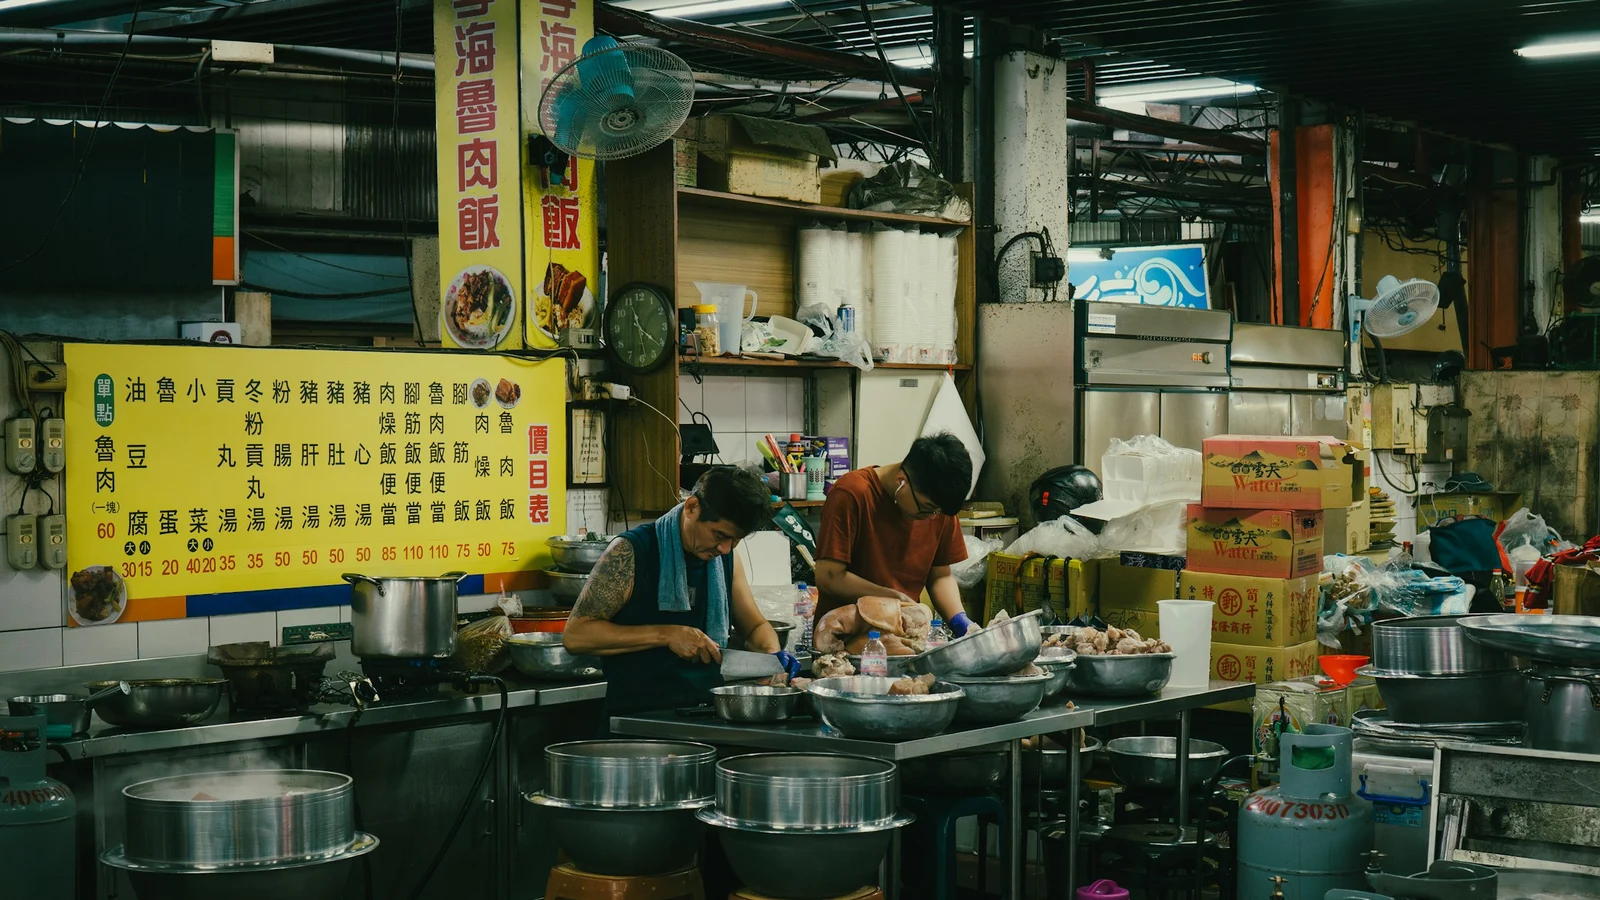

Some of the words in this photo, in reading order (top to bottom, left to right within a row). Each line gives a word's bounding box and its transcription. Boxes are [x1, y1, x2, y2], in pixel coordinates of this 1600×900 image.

[625, 297, 633, 306] 11
[635, 292, 645, 301] 12
[649, 297, 654, 305] 1
[617, 309, 626, 318] 10
[657, 307, 664, 315] 2
[614, 325, 620, 333] 9
[661, 323, 667, 331] 3
[627, 350, 633, 359] 7
[651, 350, 657, 359] 5
[97, 378, 113, 422] 單點
[125, 377, 148, 536] 油豆腐
[156, 377, 179, 535] 魯蛋
[186, 378, 208, 534] 小菜
[216, 379, 238, 533] 貢丸湯
[244, 379, 266, 532] 冬粉貢丸湯
[272, 380, 293, 530] 粉腸湯
[299, 381, 320, 529] 豬肝湯
[326, 381, 347, 528] 豬肚湯
[353, 381, 372, 526] 豬心湯
[379, 382, 397, 526] 肉燥飯便當
[403, 383, 422, 525] 腳筋飯便當
[428, 382, 446, 524] 魯肉飯便當
[452, 384, 470, 522] 腳筋飯
[94, 435, 116, 493] 魯肉
[474, 413, 491, 521] 肉燥飯
[498, 412, 515, 520] 魯肉飯
[528, 425, 550, 525] 價目表
[1232, 474, 1281, 493] Water
[98, 522, 116, 539] 60
[329, 548, 345, 564] 50
[356, 547, 371, 561] 50
[382, 545, 397, 561] 85
[404, 544, 424, 560] 110
[429, 544, 449, 559] 110
[456, 543, 471, 559] 75
[477, 542, 491, 557] 50
[501, 541, 515, 555] 75
[1213, 540, 1258, 561] Water
[185, 557, 201, 574] 40
[202, 557, 217, 573] 20
[219, 555, 235, 571] 35
[247, 552, 265, 569] 35
[274, 551, 291, 567] 50
[302, 549, 319, 565] 50
[122, 563, 137, 578] 30
[137, 561, 153, 577] 15
[161, 559, 179, 576] 20
